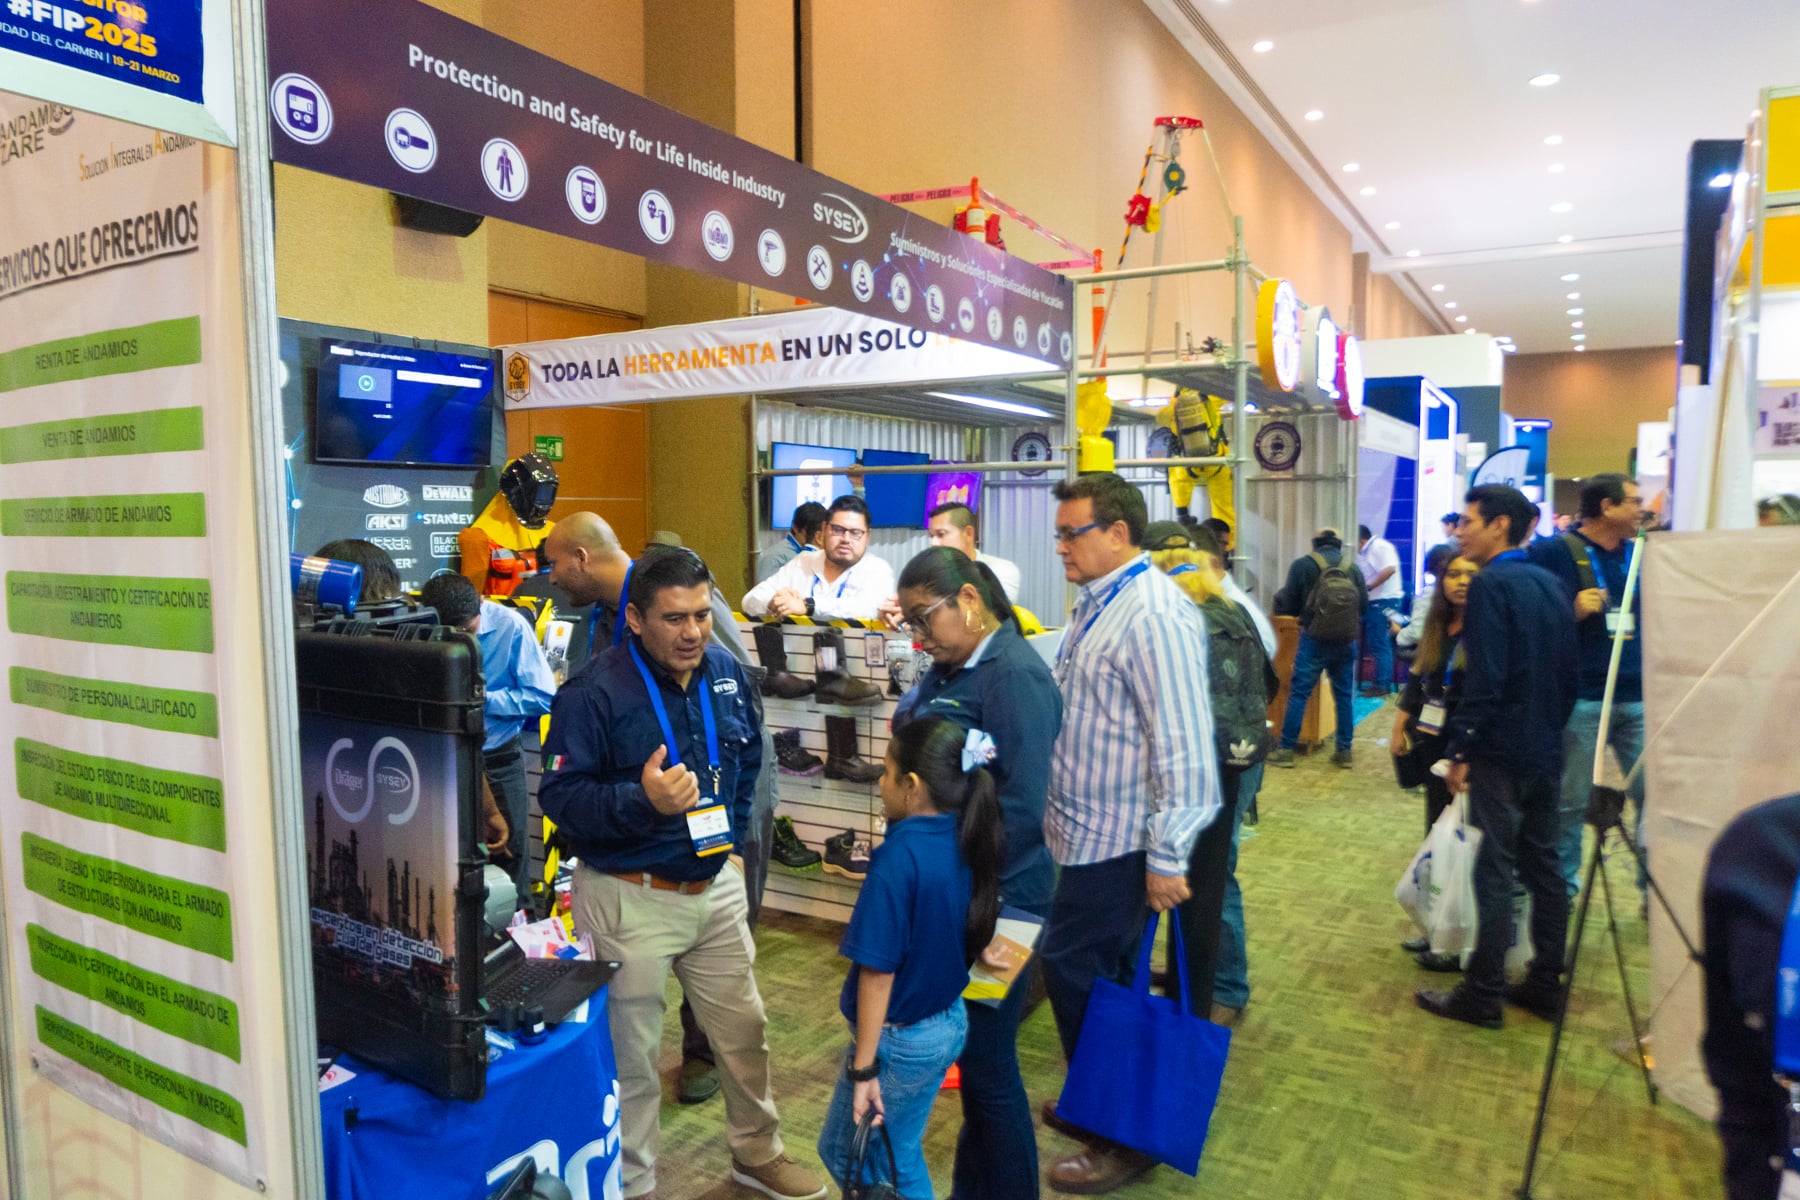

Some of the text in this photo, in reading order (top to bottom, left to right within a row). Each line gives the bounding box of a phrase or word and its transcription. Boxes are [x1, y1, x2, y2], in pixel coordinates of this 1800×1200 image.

[32, 31, 52, 46] DEL
[55, 39, 104, 61] CARMEN
[142, 64, 181, 83] MARZO
[408, 44, 786, 208] Protection and Safety for Life Inside Industry
[813, 203, 862, 235] SYSEY
[54, 231, 87, 275] QUE
[91, 201, 198, 264] OFRECEMOS
[890, 232, 941, 264] Suministros
[947, 255, 986, 281] Soluciones
[36, 339, 138, 370] RENTA DE ANDAMIOS
[541, 361, 593, 384] TODA
[596, 357, 620, 380] LA
[624, 341, 777, 377] HERRAMIENTA
[782, 339, 813, 362] EN
[818, 333, 853, 357] UN
[859, 327, 927, 353] SOLO
[42, 425, 136, 448] VENTA DE ANDAMIOS
[66, 506, 102, 523] ARMADO
[105, 506, 120, 523] DE
[122, 505, 172, 523] ANDAMIOS
[423, 513, 474, 525] STANLEY
[128, 587, 195, 608] CERTIFICACIÓN
[197, 592, 210, 609] DE
[68, 686, 80, 702] DE
[81, 689, 135, 710] PERSONAL
[135, 695, 197, 719] CALIFICADO
[67, 762, 95, 782] ESTADO
[125, 773, 136, 790] DE
[136, 776, 151, 794] LOS
[152, 780, 221, 808] COMPONENTES
[376, 773, 406, 788] SYSEY
[122, 898, 138, 918] CON
[137, 903, 182, 931] ANDAMIOS
[147, 883, 170, 902] PARA
[173, 890, 183, 908] EL
[185, 894, 224, 919] ARMADO
[363, 923, 380, 940] en
[375, 943, 412, 969] gases
[146, 981, 159, 999] EN
[161, 985, 172, 1004] EL
[173, 989, 215, 1020] ARMADO
[217, 1006, 229, 1026] DE
[144, 1068, 188, 1100] PERSONAL
[196, 1090, 238, 1125] MATERIAL
